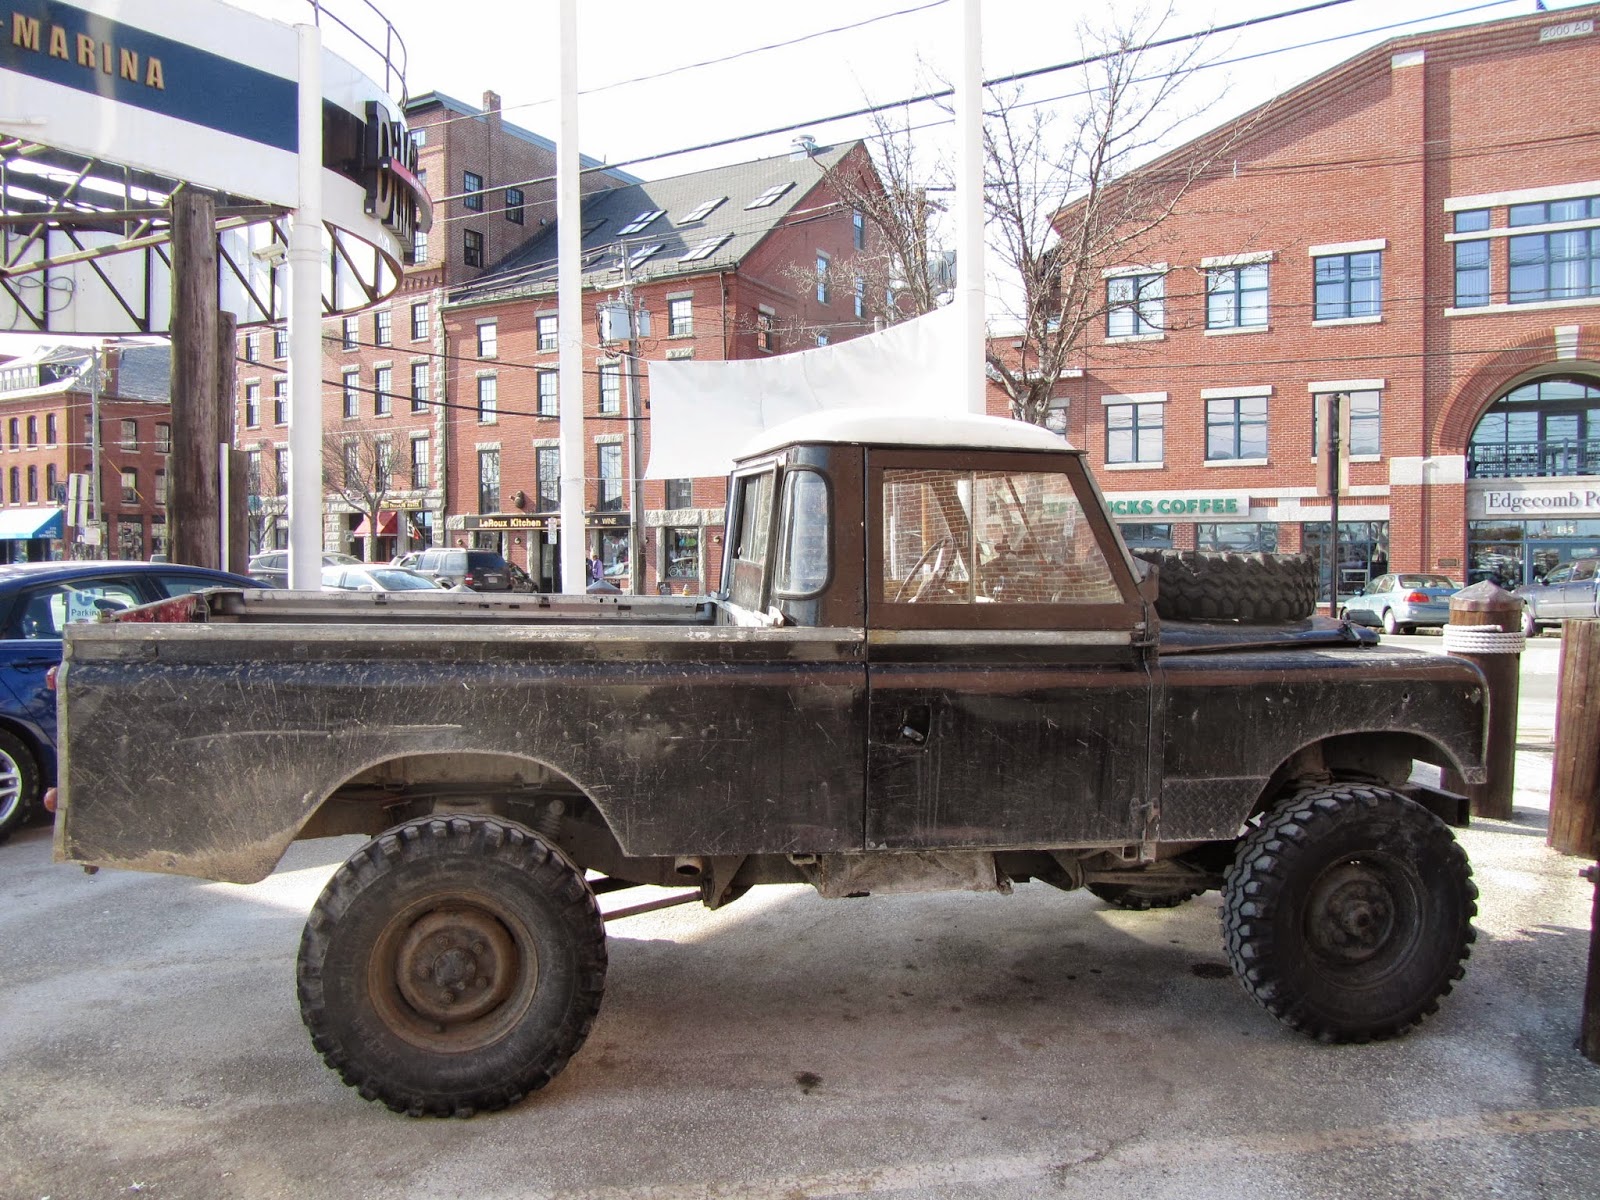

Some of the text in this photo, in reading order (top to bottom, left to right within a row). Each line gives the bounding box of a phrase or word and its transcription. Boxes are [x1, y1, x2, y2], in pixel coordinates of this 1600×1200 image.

[1542, 21, 1590, 38] 2000 AD
[12, 11, 165, 90] MARINA
[1157, 499, 1238, 513] COFFEE
[1488, 491, 1579, 512] Edgecomb
[479, 518, 541, 527] LeRoux Kitchen
[601, 517, 617, 525] WINE
